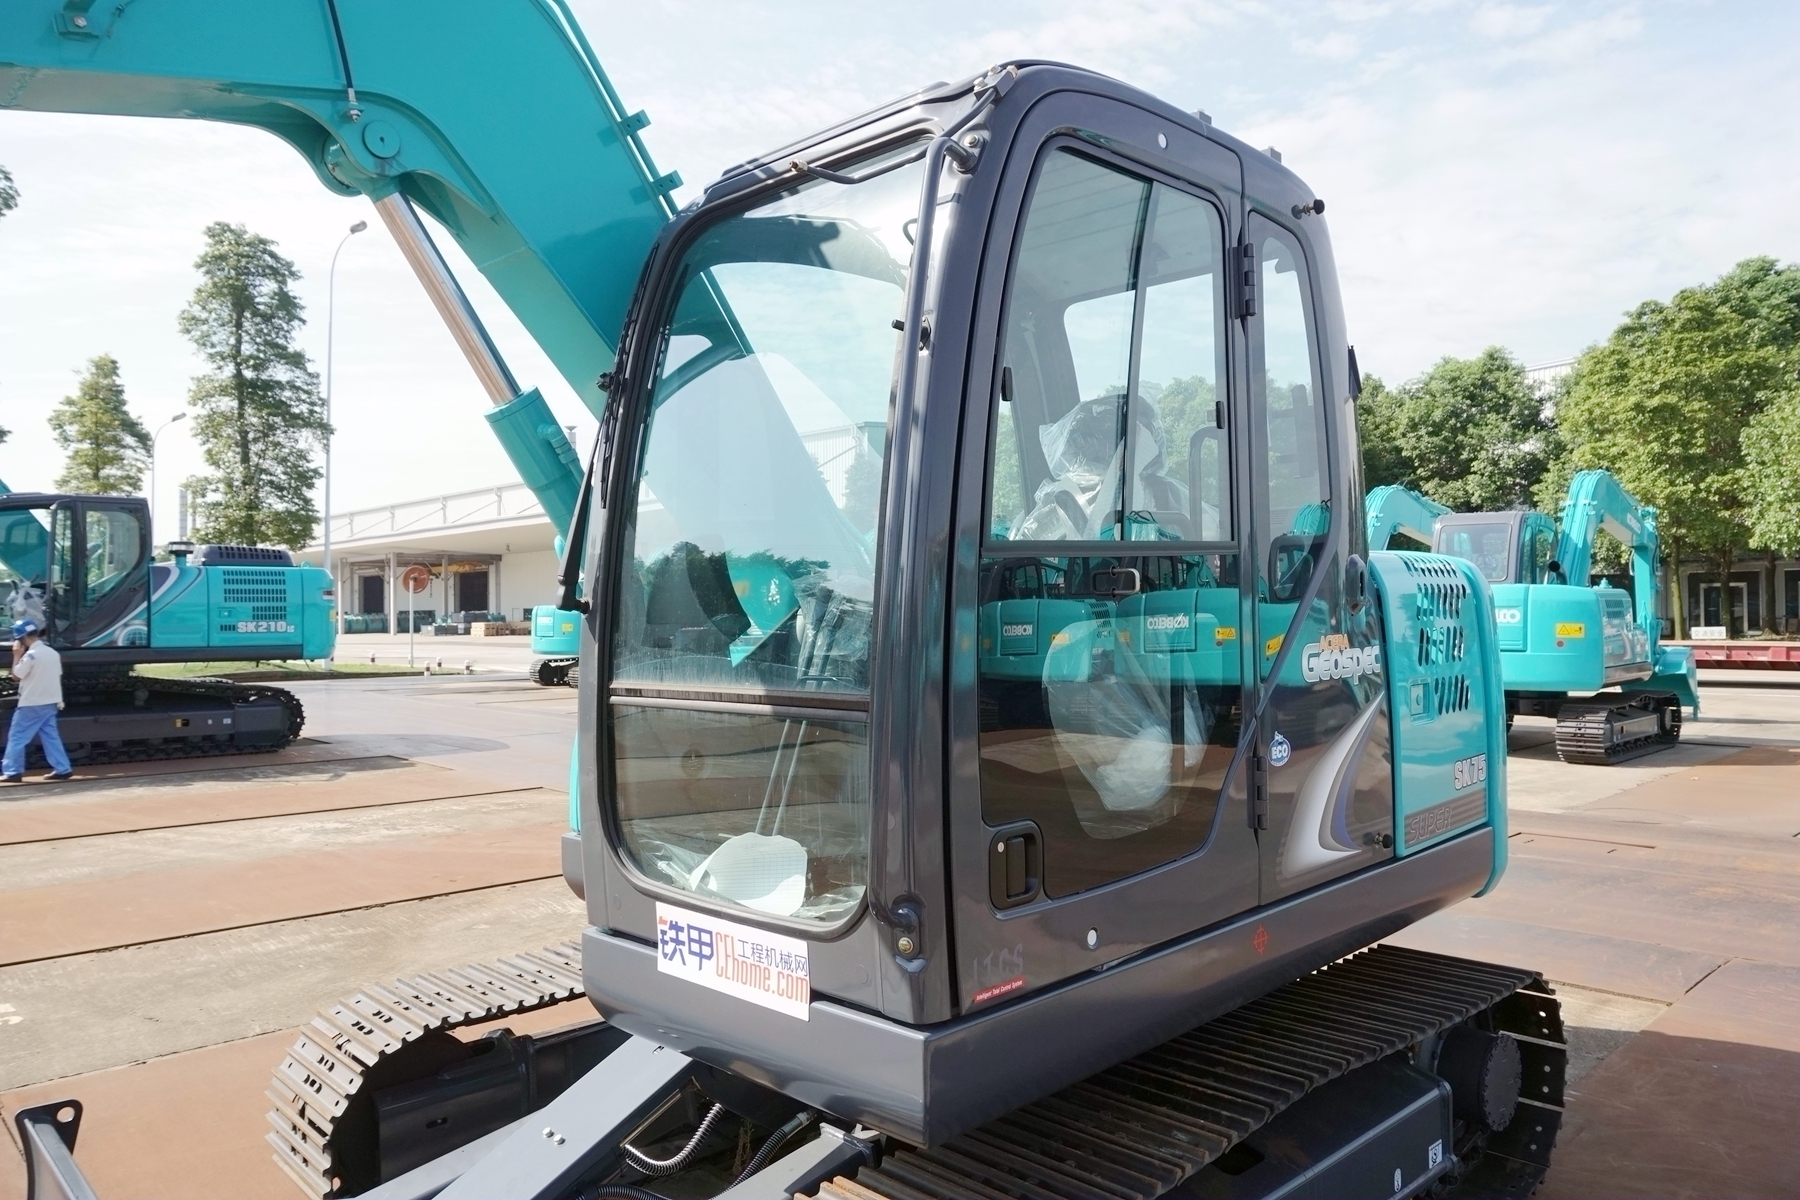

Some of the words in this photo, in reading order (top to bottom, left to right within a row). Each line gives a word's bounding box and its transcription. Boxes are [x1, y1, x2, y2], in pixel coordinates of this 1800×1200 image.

[1271, 744, 1289, 759] ECO
[1454, 753, 1487, 790] SK75
[1408, 806, 1452, 844] SUPER
[658, 916, 714, 971] 铁甲
[738, 939, 808, 977] 工程机械网
[715, 931, 809, 1005] CEhome.com
